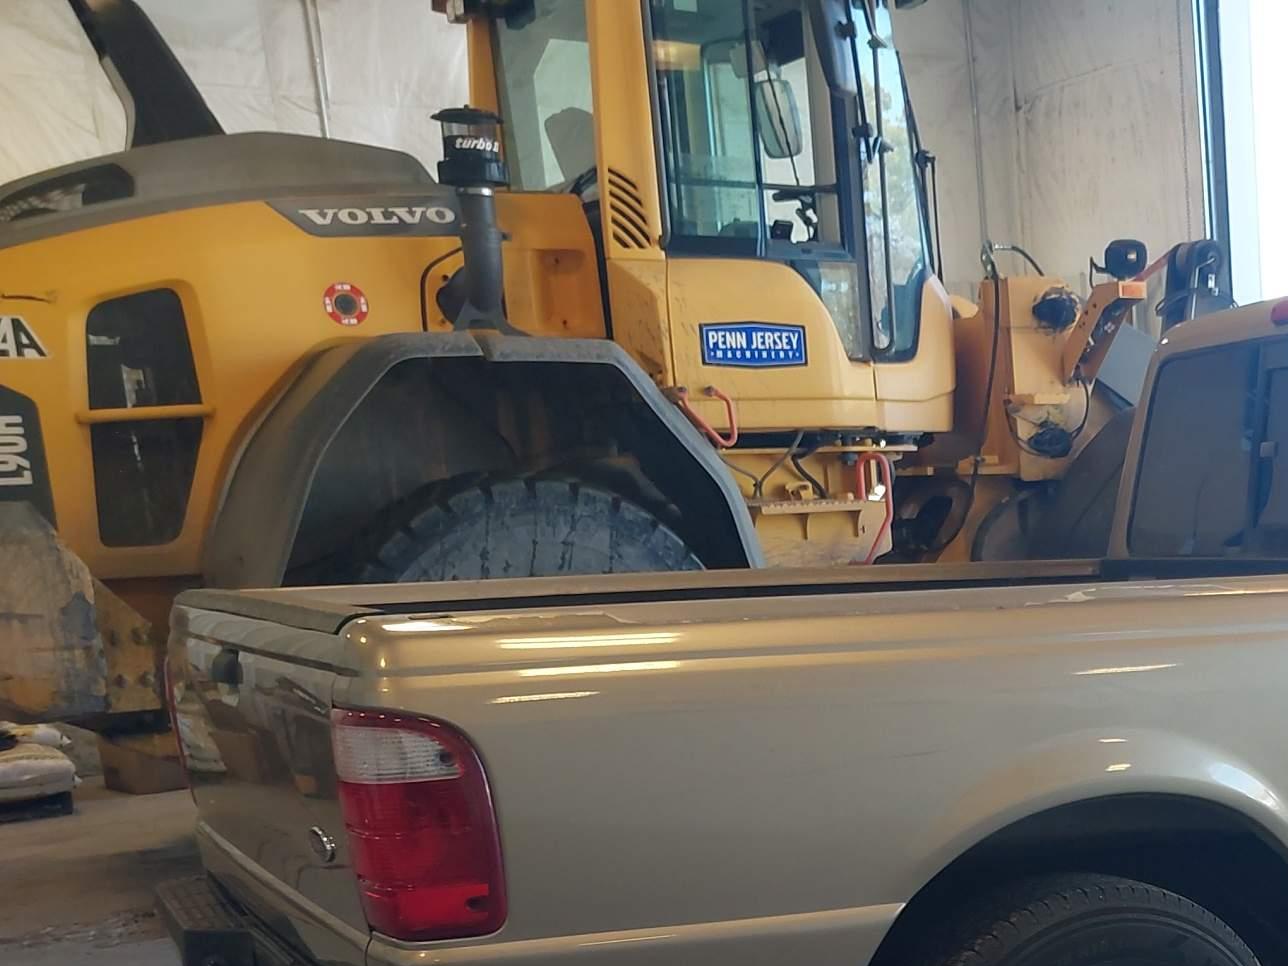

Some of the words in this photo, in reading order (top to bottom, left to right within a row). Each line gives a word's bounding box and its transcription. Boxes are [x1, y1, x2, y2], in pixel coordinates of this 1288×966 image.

[455, 137, 492, 151] turbo
[298, 207, 455, 225] VOLVO
[708, 330, 747, 349] PENN
[751, 331, 798, 350] JERSEY
[715, 350, 793, 359] MACHINERY
